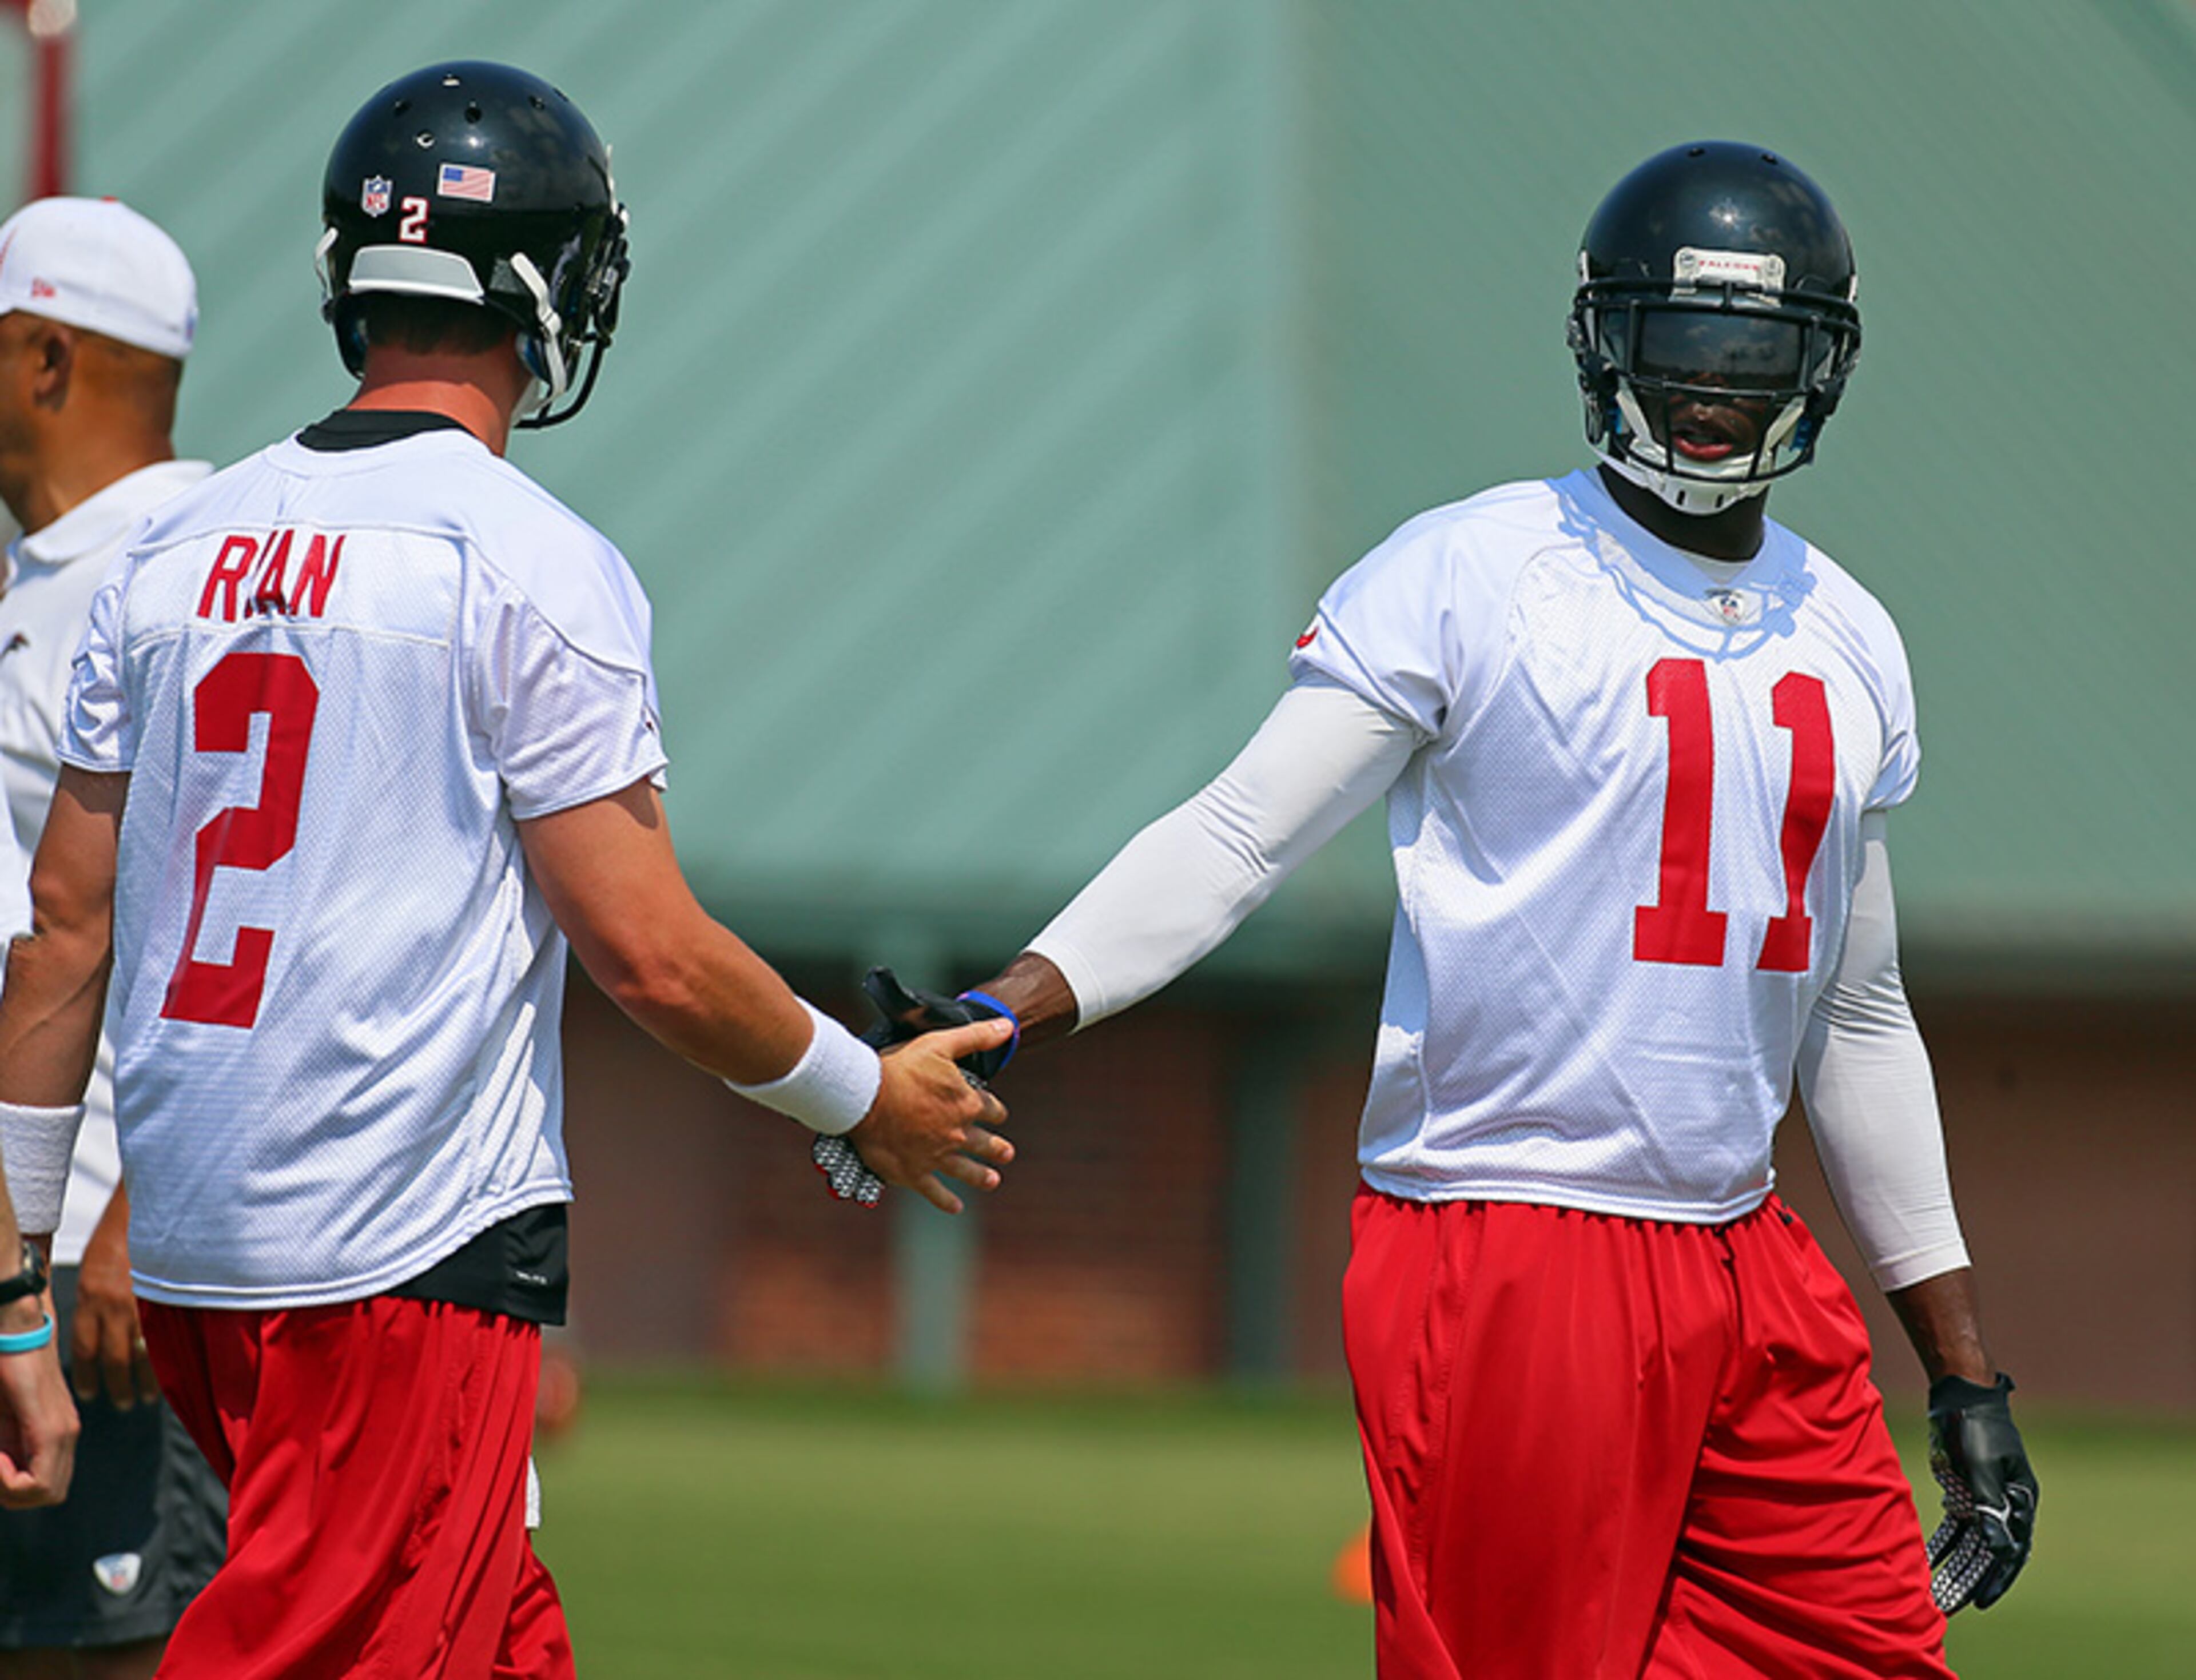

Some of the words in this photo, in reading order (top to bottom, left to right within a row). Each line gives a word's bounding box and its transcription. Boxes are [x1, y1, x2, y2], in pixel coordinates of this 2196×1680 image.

[399, 196, 430, 245] 2
[160, 652, 320, 1029] 2
[1633, 658, 1836, 972] 11
